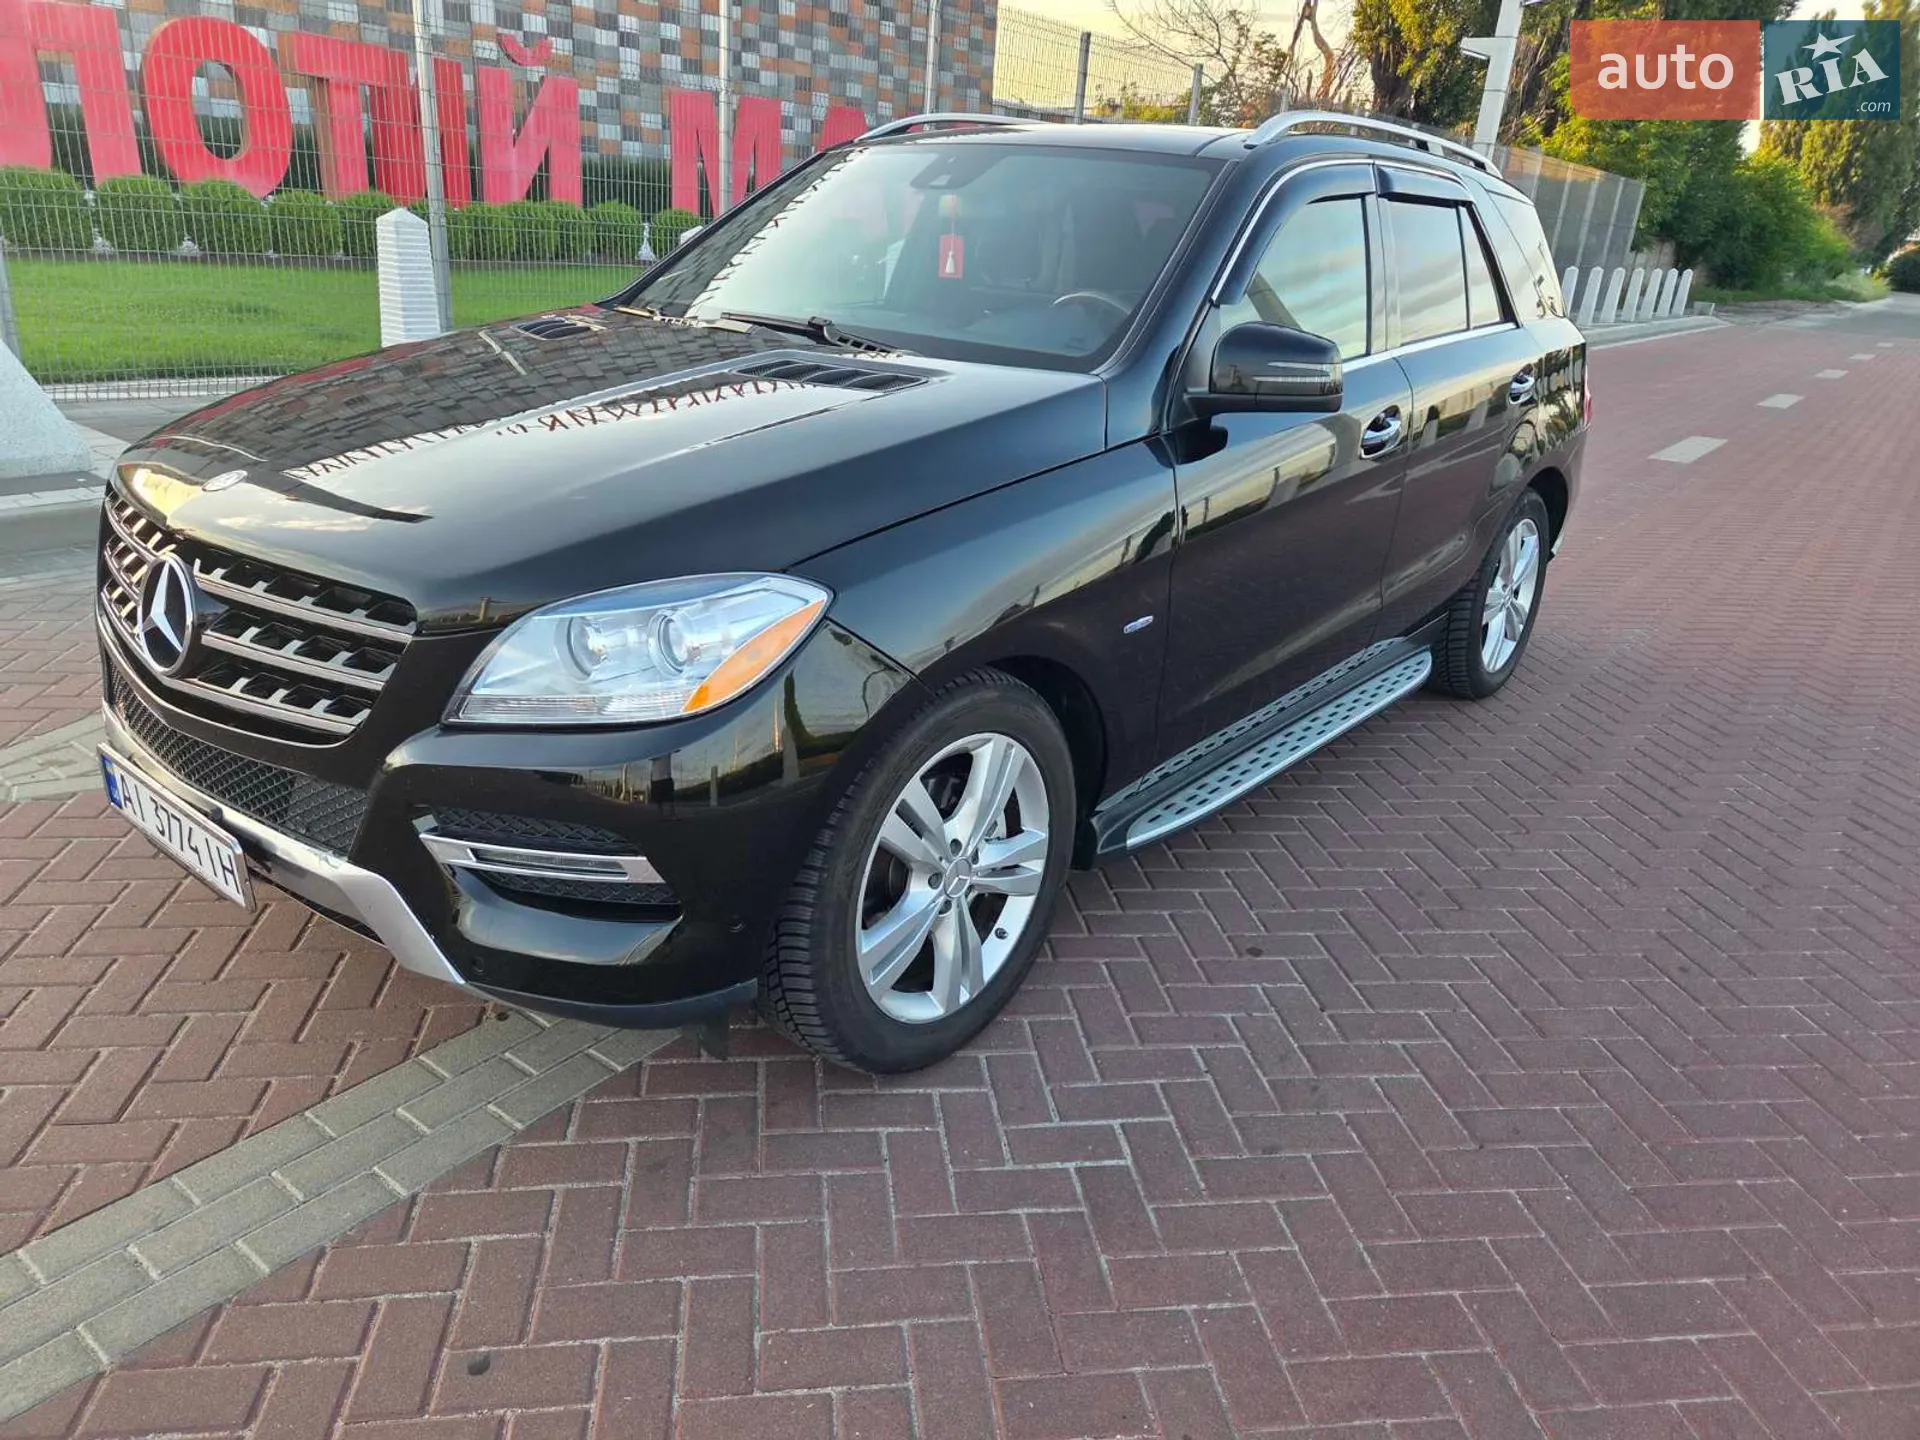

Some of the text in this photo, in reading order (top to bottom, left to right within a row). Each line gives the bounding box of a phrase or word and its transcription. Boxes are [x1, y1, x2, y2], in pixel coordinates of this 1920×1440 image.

[120, 773, 241, 895] AI 3774 IH
